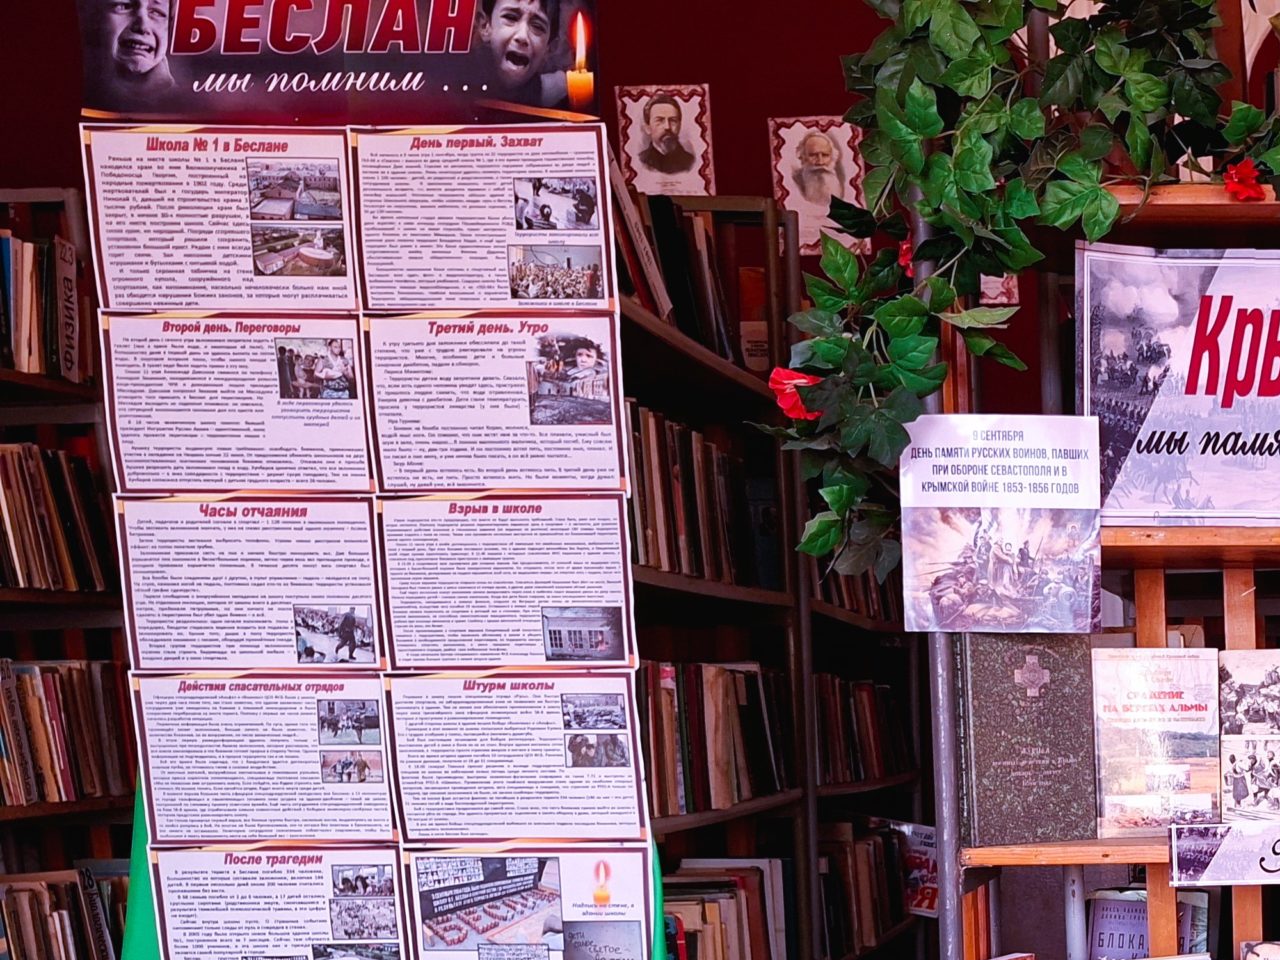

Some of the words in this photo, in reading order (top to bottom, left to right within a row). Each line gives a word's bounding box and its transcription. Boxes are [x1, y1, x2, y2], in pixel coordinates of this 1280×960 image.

[171, 0, 474, 55] БЕСЛАН
[193, 75, 255, 92] мы
[266, 70, 425, 92] помним
[146, 136, 189, 153] Школа
[193, 137, 209, 152] №
[211, 137, 219, 152] 1
[223, 142, 231, 152] в
[234, 138, 288, 154] Беслане
[411, 135, 443, 150] День
[446, 136, 496, 152] первый.
[500, 135, 543, 149] Захват
[63, 277, 75, 371] Физика
[162, 321, 200, 335] Второй
[203, 323, 232, 335] день.
[235, 322, 301, 336] Переговоры
[428, 321, 474, 334] Третий
[479, 323, 513, 336] день.
[517, 321, 548, 336] Утро
[981, 430, 1024, 441] СЕНТЯБРЯ
[1136, 430, 1189, 454] мы
[911, 448, 933, 459] ДЕНЬ
[935, 448, 970, 457] ПАМЯТИ
[972, 448, 1010, 458] РУССКИХ
[1013, 448, 1049, 459] ВОИНОВ,
[1052, 449, 1088, 459] ПАВШИХ
[932, 464, 949, 475] ПРИ
[951, 465, 988, 475] ОБОРОНЕ
[991, 465, 1051, 475] СЕВАСТОПОЛЯ
[1054, 467, 1060, 476] И
[1062, 467, 1067, 476] В
[922, 480, 968, 492] КРЫМСКОЙ
[971, 480, 999, 492] ВОЙНЕ
[1003, 483, 1049, 493] 1853-1856
[1051, 484, 1079, 494] ГОДОВ
[199, 504, 237, 518] Часы
[242, 506, 307, 518] отчаяния
[449, 503, 486, 517] Взрыв
[501, 504, 542, 514] школе
[178, 680, 225, 693] Действия
[227, 681, 301, 693] спасательных
[304, 681, 344, 693] отрядов
[463, 679, 506, 692] Штурм
[509, 679, 554, 691] школы
[1169, 704, 1208, 712] АЛЬМЫ
[224, 853, 261, 865] После
[265, 853, 322, 866] трагедии
